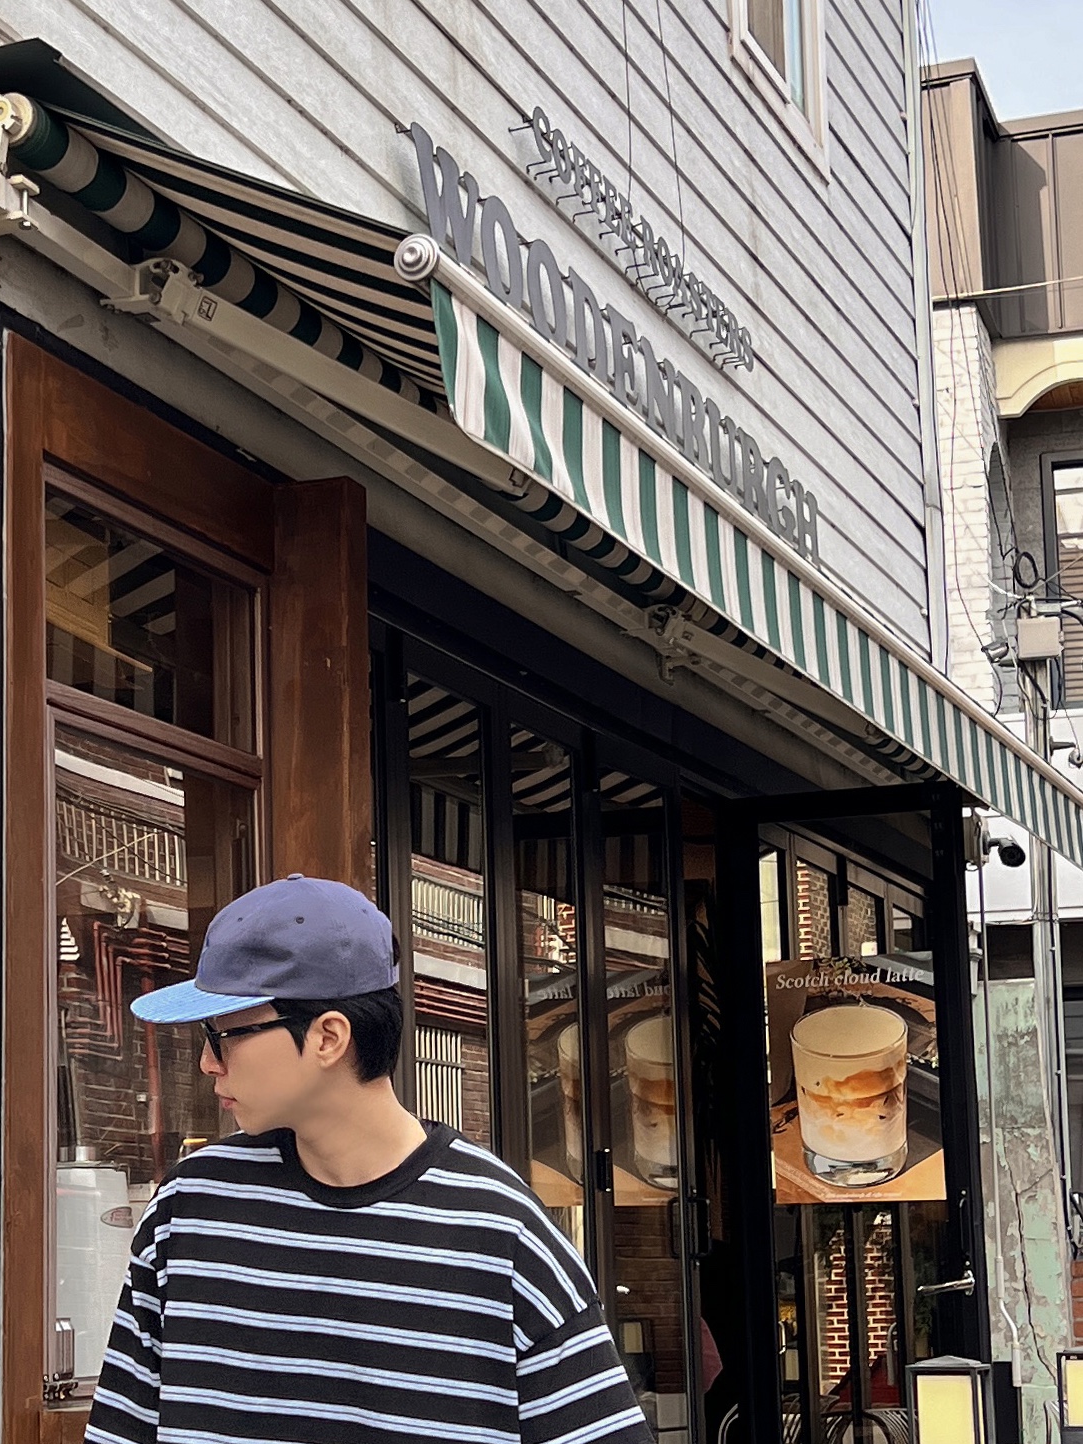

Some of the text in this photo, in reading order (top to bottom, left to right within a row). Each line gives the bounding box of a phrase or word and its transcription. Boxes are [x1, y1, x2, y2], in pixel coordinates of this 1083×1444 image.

[411, 121, 819, 565] WOODENBURGH
[532, 106, 754, 373] COFFEE ROASTERS
[775, 967, 925, 990] Scotch cloud latte
